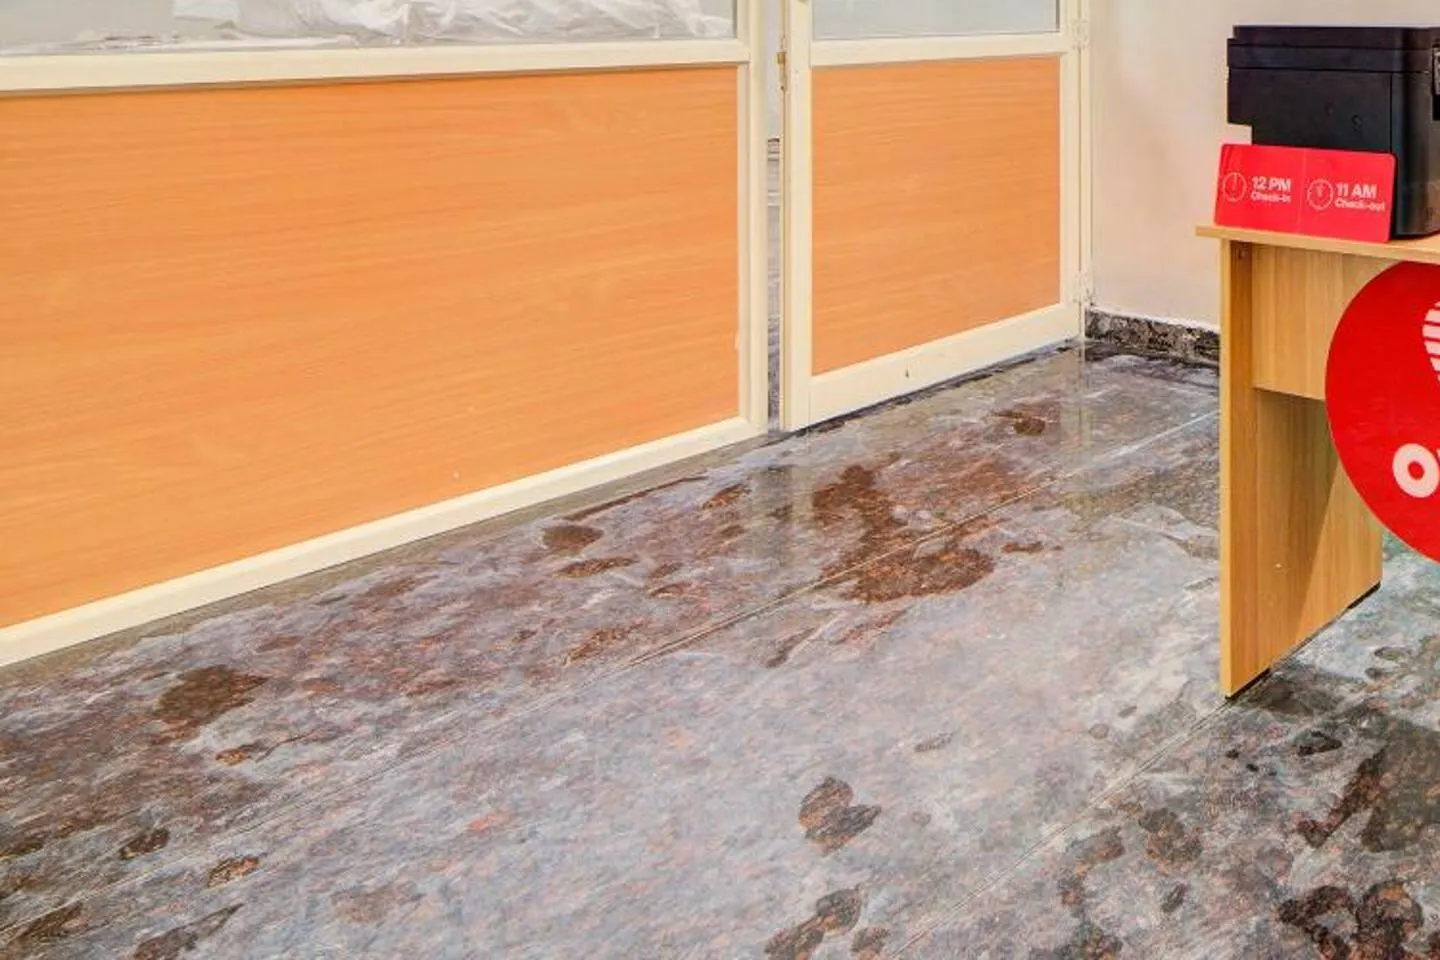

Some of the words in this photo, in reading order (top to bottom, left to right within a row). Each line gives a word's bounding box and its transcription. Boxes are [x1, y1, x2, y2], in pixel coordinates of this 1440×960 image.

[1251, 176, 1266, 189] 12
[1268, 177, 1292, 192] PM
[1336, 182, 1349, 196] 11
[1351, 183, 1377, 198] AM
[1335, 198, 1385, 211] Check-out
